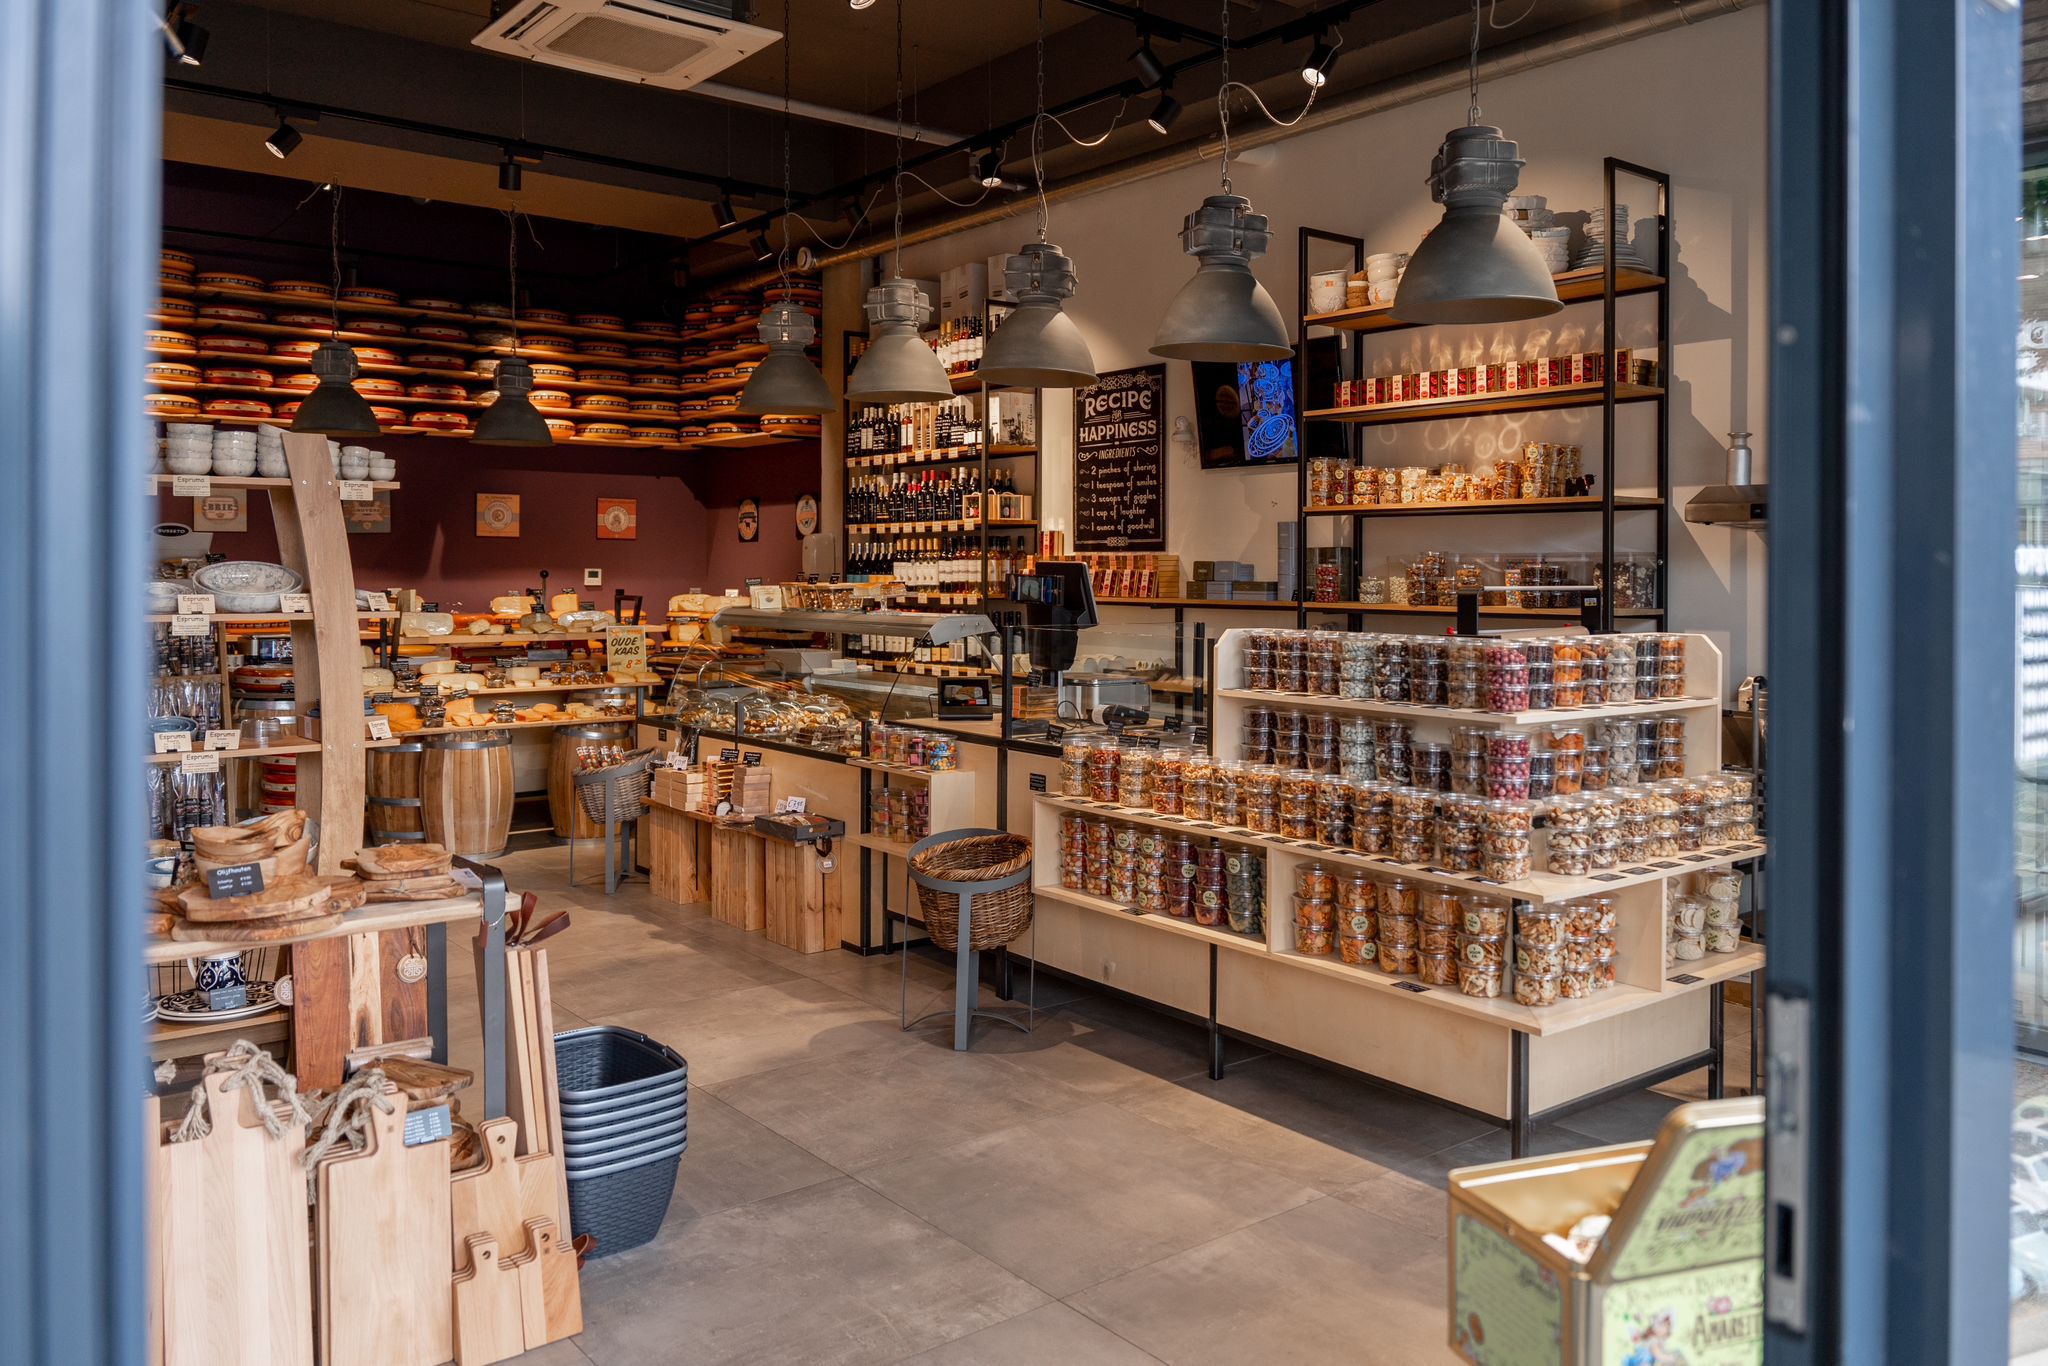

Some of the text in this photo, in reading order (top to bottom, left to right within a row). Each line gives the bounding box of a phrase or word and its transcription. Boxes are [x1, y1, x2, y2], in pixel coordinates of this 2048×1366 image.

[1085, 390, 1152, 419] RECIPE
[1080, 420, 1157, 442] HAPPINESS
[1098, 446, 1136, 460] INGREDIENTS
[1091, 460, 1157, 478] 2 pinches of sharing
[177, 476, 205, 484] Espruma
[1096, 481, 1125, 492] teaspoon
[1126, 475, 1134, 490] of
[1136, 475, 1157, 486] smiles
[1091, 489, 1157, 505] 3 scoops of giggles
[207, 503, 234, 511] BRIE
[1096, 511, 1108, 520] cup
[1109, 505, 1118, 520] of
[1120, 504, 1146, 519] laughter
[1117, 518, 1125, 534] of
[1127, 518, 1155, 534] goodwill
[283, 594, 309, 602] Espruma
[176, 615, 204, 623] Espruma
[611, 637, 638, 647] OUDE
[613, 646, 640, 657] KAAS
[158, 733, 186, 741] Espruma
[209, 731, 236, 739] Espruma
[186, 753, 214, 761] Espruma
